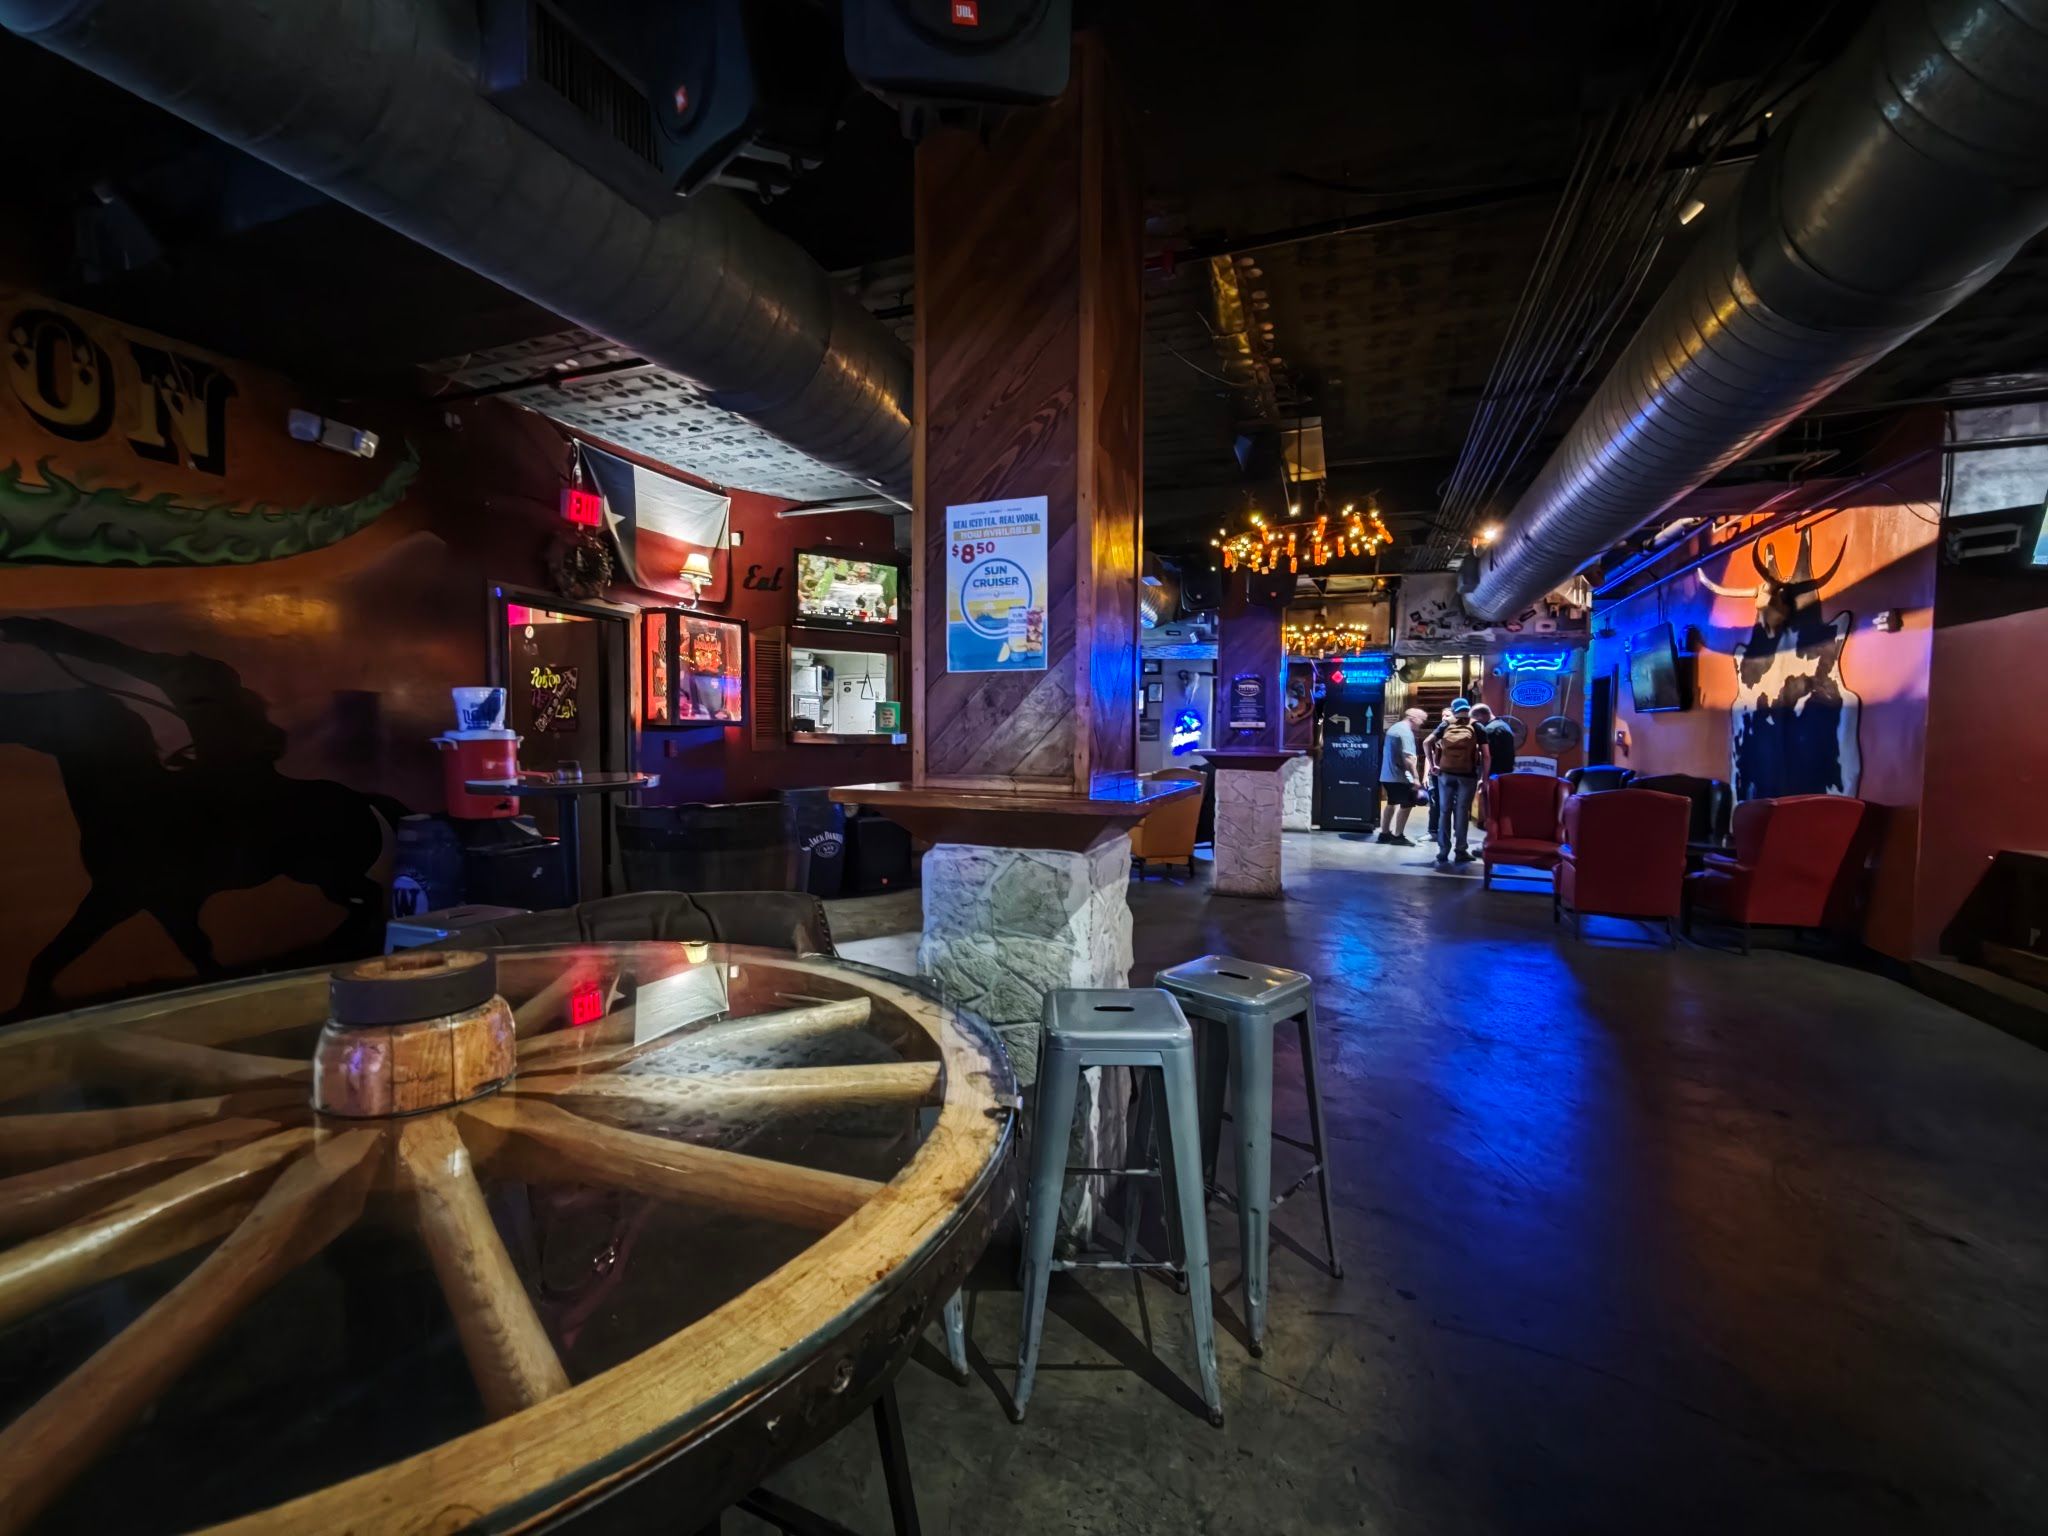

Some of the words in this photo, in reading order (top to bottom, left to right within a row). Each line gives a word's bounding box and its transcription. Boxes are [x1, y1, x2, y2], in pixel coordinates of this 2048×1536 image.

[956, 4, 975, 19] JBL
[572, 493, 599, 522] EXIT
[953, 520, 968, 530] REAL
[969, 518, 984, 528] ICED
[999, 514, 1015, 525] REAL
[1016, 512, 1041, 523] VODKA.
[743, 563, 784, 592] Eat
[984, 565, 1008, 576] SUN
[972, 576, 1020, 588] CRUISER
[809, 834, 825, 848] JACK
